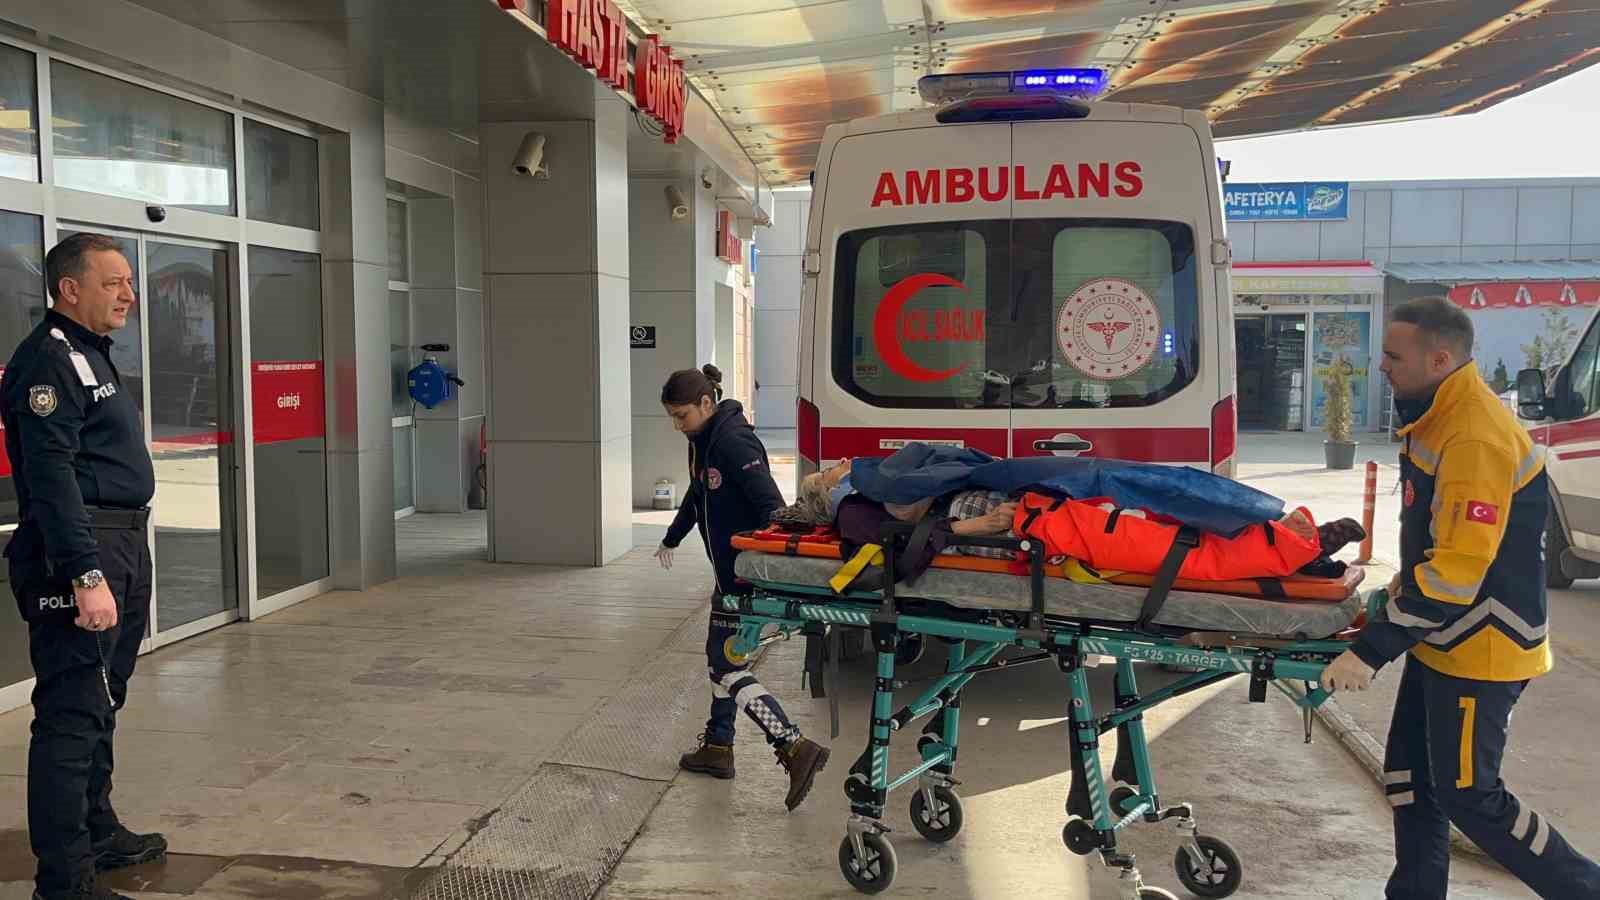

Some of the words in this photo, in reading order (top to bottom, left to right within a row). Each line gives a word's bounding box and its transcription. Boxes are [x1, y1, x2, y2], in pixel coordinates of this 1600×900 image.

[552, 0, 628, 91] HASTA
[871, 161, 1143, 207] AMBULANS
[1225, 190, 1297, 207] AFETERYA
[277, 392, 300, 410] GİRİŞİ
[39, 594, 75, 610] POLİ
[1175, 652, 1227, 668] TARGET
